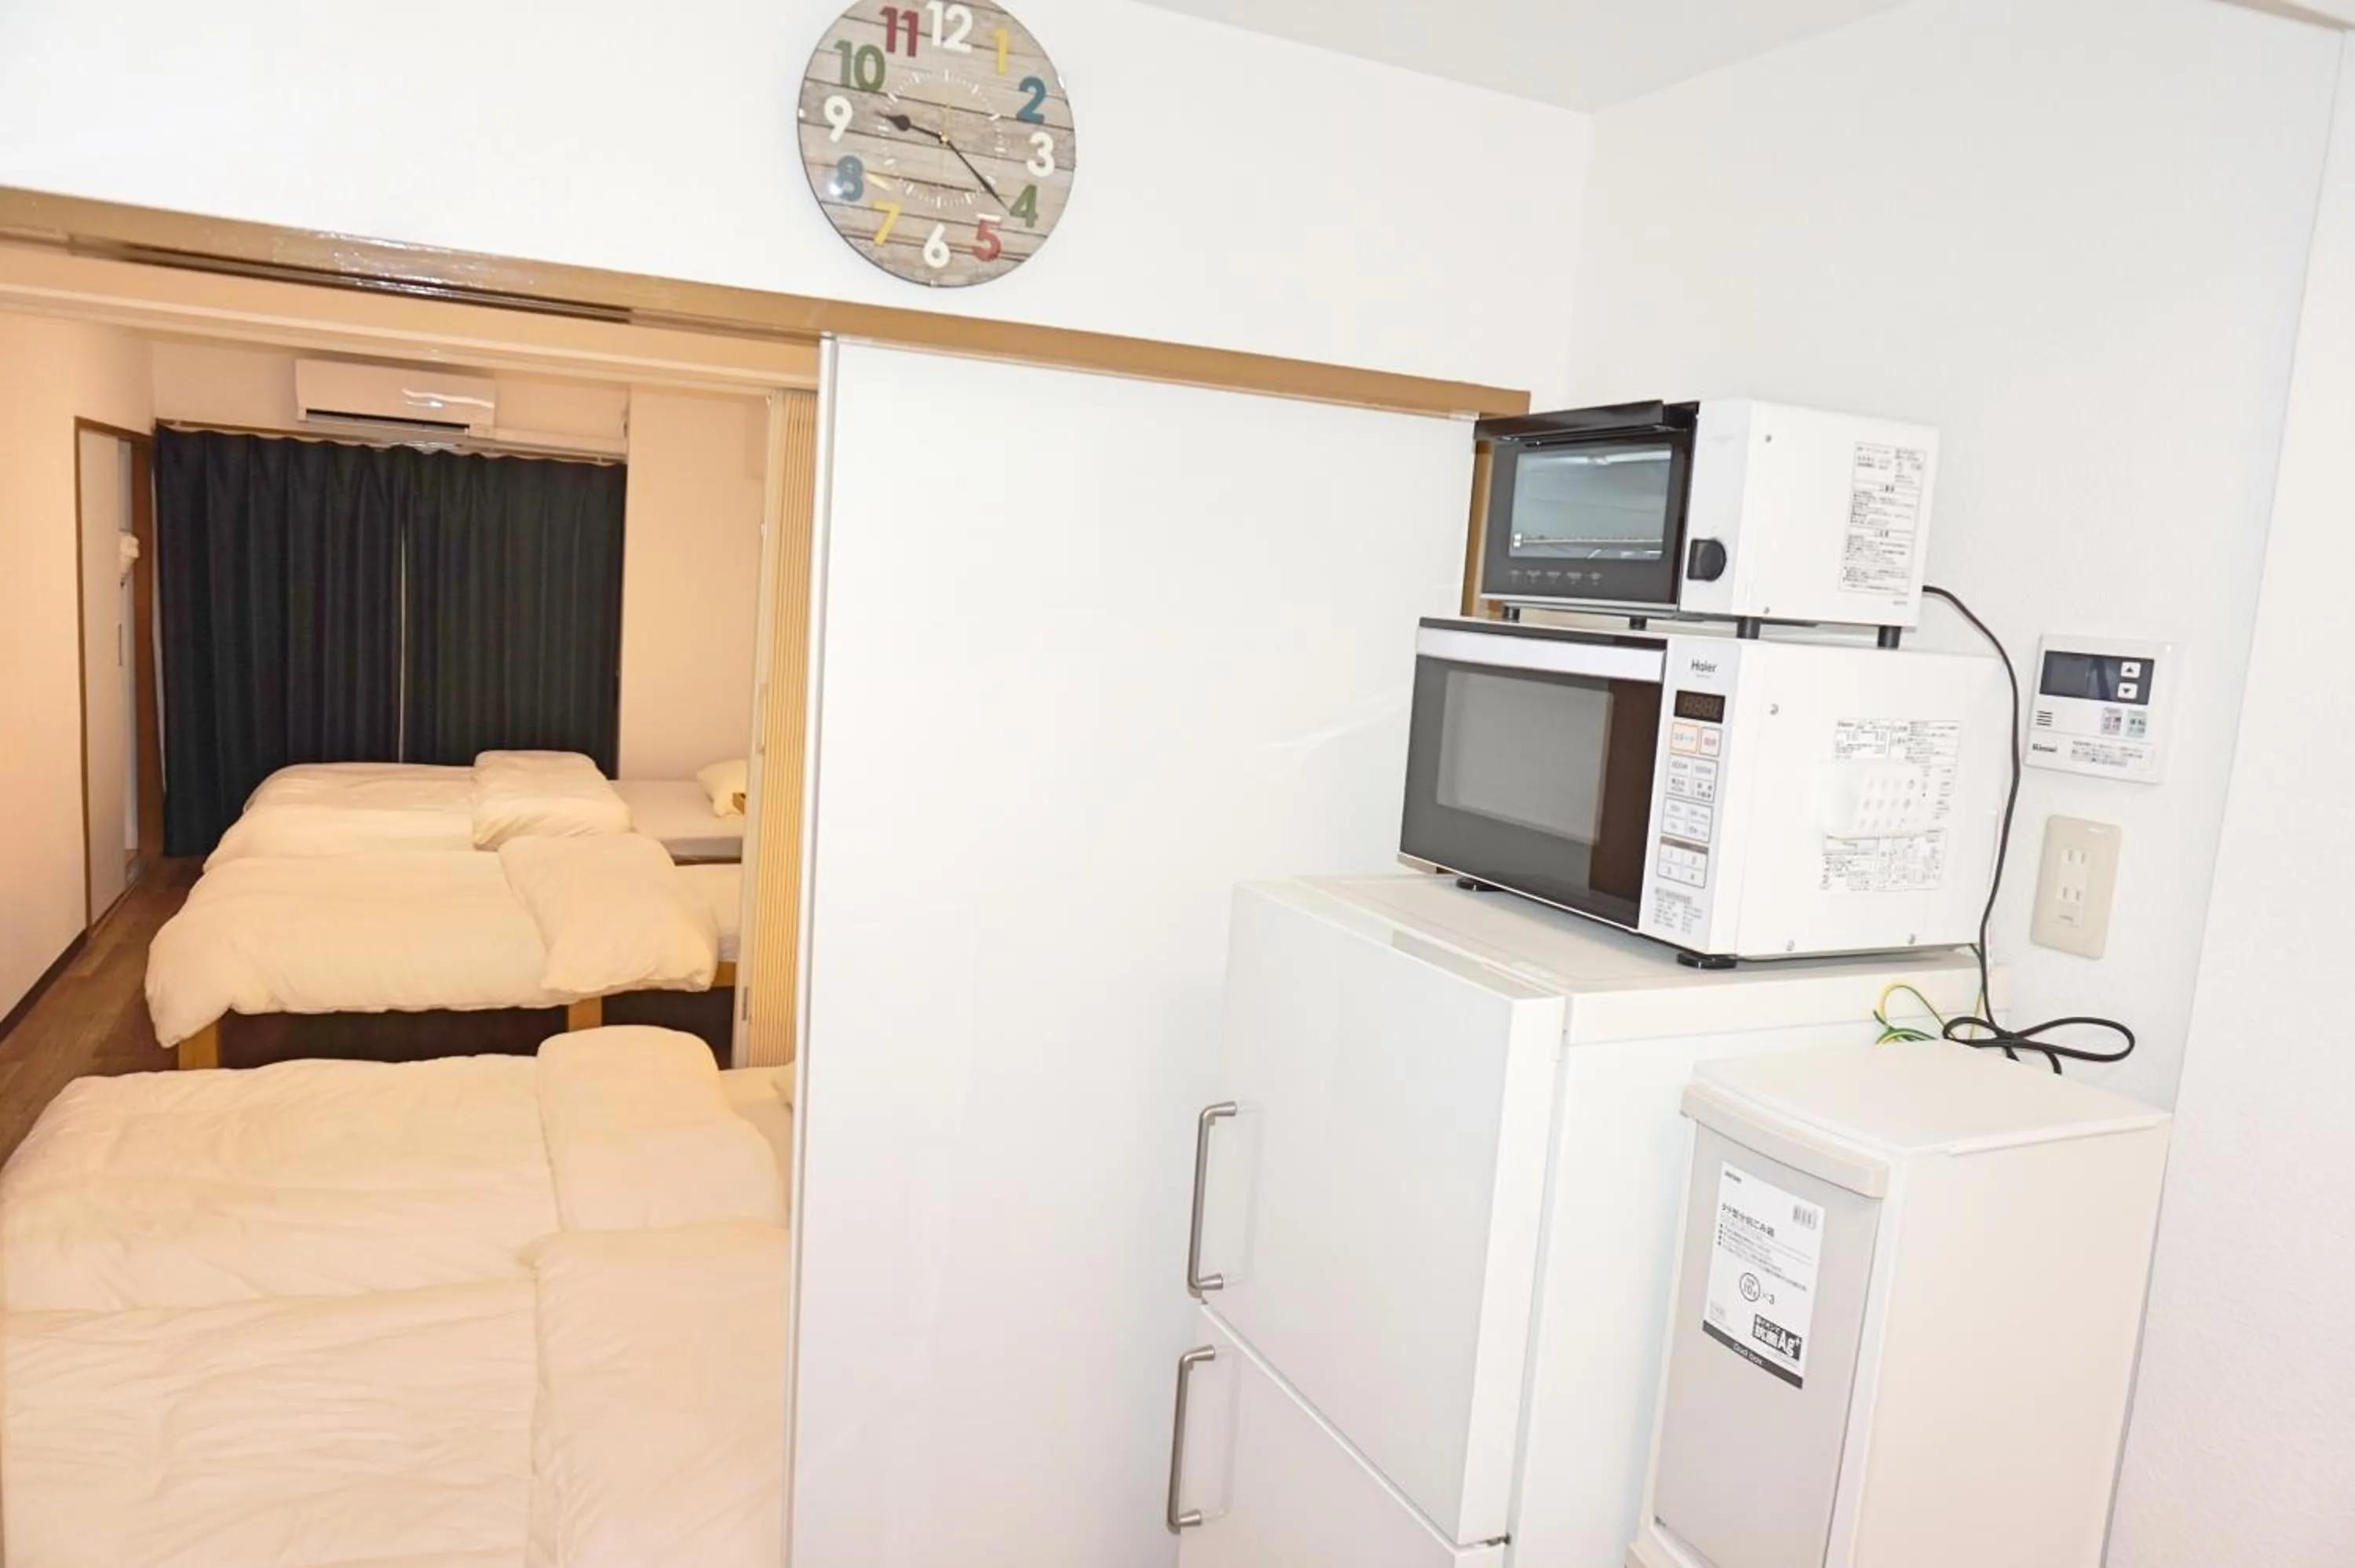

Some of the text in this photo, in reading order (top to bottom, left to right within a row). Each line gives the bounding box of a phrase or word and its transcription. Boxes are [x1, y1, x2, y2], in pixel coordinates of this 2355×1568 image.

[879, 6, 919, 57] 11
[926, 0, 973, 53] 12
[834, 40, 885, 93] 10
[992, 28, 1009, 75] 1
[824, 95, 853, 143] 9
[1017, 76, 1046, 124] 2
[1027, 132, 1055, 177] 3
[835, 155, 864, 202] 8
[871, 200, 900, 246] 7
[1010, 184, 1039, 228] 4
[923, 224, 950, 268] 6
[972, 217, 1002, 261] 5
[1691, 658, 1717, 673] Haier
